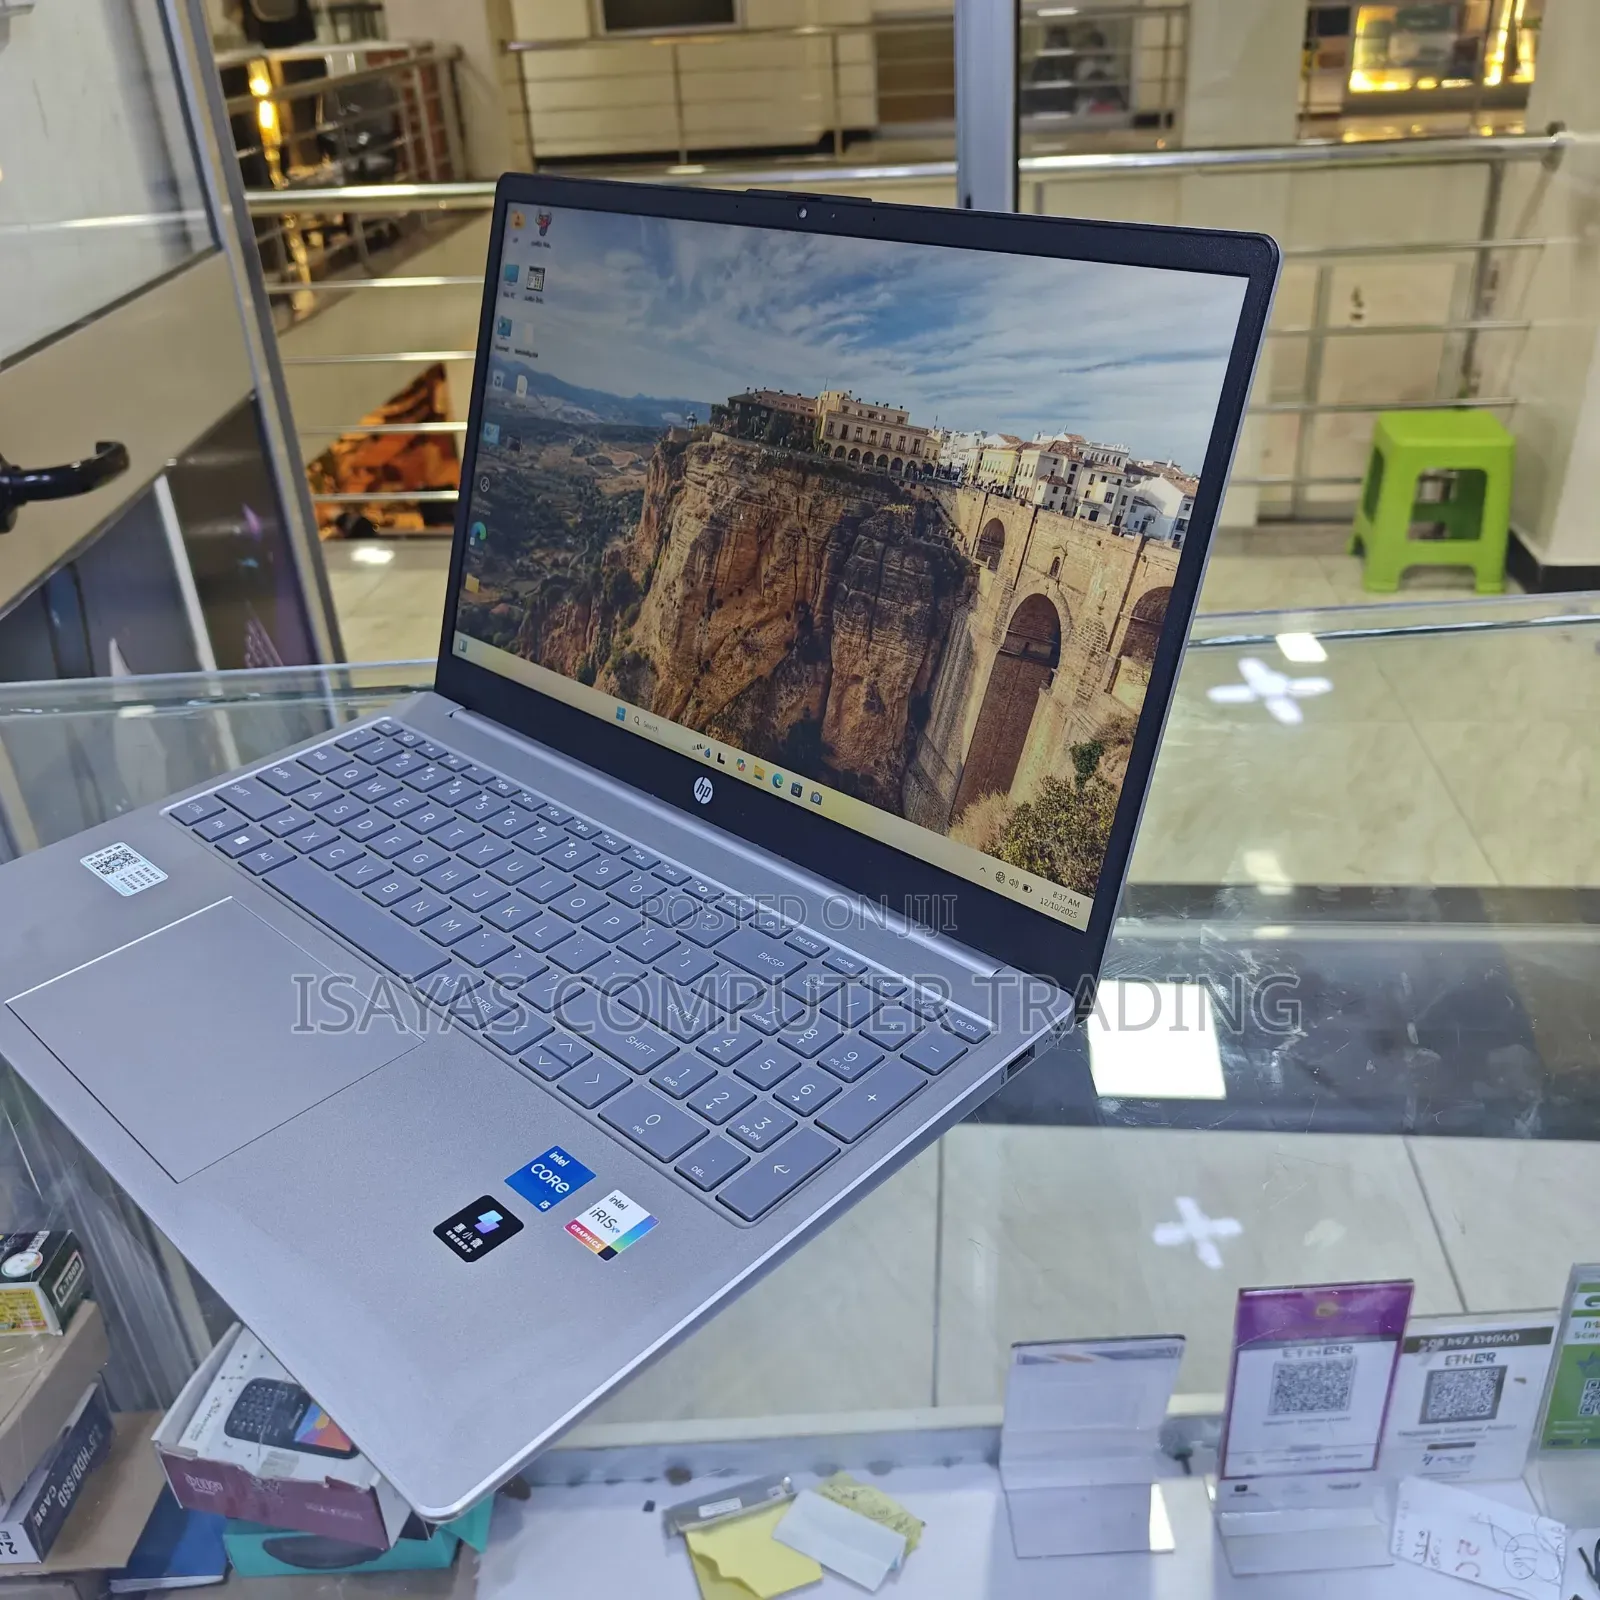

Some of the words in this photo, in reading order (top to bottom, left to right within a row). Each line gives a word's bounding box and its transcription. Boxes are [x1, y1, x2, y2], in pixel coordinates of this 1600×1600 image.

[272, 766, 292, 779] CAPS
[344, 769, 359, 778] Q
[232, 784, 252, 798] SHIFT
[368, 782, 387, 793] W
[694, 776, 714, 804] hp
[308, 790, 323, 800] A
[393, 798, 410, 807] E
[188, 802, 204, 816] CTRL
[334, 805, 348, 814] S
[278, 816, 296, 826] Z
[420, 812, 436, 823] R
[212, 820, 224, 829] FN
[357, 820, 374, 830] D
[302, 832, 320, 842] X
[450, 828, 464, 838] T
[384, 836, 402, 845] F
[329, 848, 345, 858] C
[478, 844, 494, 854] Y
[564, 850, 578, 859] 8
[258, 852, 274, 862] ALT
[412, 854, 429, 864] G
[357, 865, 374, 875] V
[507, 862, 524, 872] U
[595, 866, 609, 876] 9
[440, 870, 459, 881] H
[382, 882, 400, 894] B
[472, 890, 489, 898] J
[1052, 891, 1068, 902] 8:37
[1068, 898, 1080, 908] AM
[410, 900, 430, 914] N
[502, 905, 522, 918] K
[1040, 898, 1078, 919] 12/10/2025
[440, 919, 462, 932] M
[603, 916, 620, 926] P
[534, 926, 548, 938] L
[795, 934, 818, 950] DELETE
[757, 952, 786, 968] BKSP
[836, 956, 855, 969] HOME
[440, 976, 459, 988] ALT
[471, 996, 494, 1014] CTRL
[666, 1003, 701, 1026] ENTER
[752, 1012, 772, 1026] HOME
[804, 1028, 818, 1040] 8
[625, 1036, 656, 1056] SHIFT
[722, 1038, 737, 1048] 4
[844, 1052, 858, 1062] 9
[759, 1058, 776, 1070] 5
[663, 1076, 678, 1088] END
[800, 1084, 816, 1096] 6
[713, 1092, 730, 1106] 2
[754, 1117, 772, 1130] 3
[632, 1124, 645, 1136] INS
[738, 1124, 752, 1135] PG
[748, 1130, 762, 1142] DN
[548, 1151, 570, 1168] intel
[690, 1165, 704, 1178] DEL
[539, 1200, 552, 1210] i5
[609, 1195, 629, 1211] intel
[570, 1224, 602, 1250] GRAPHICS
[34, 1486, 57, 1526] CASE
